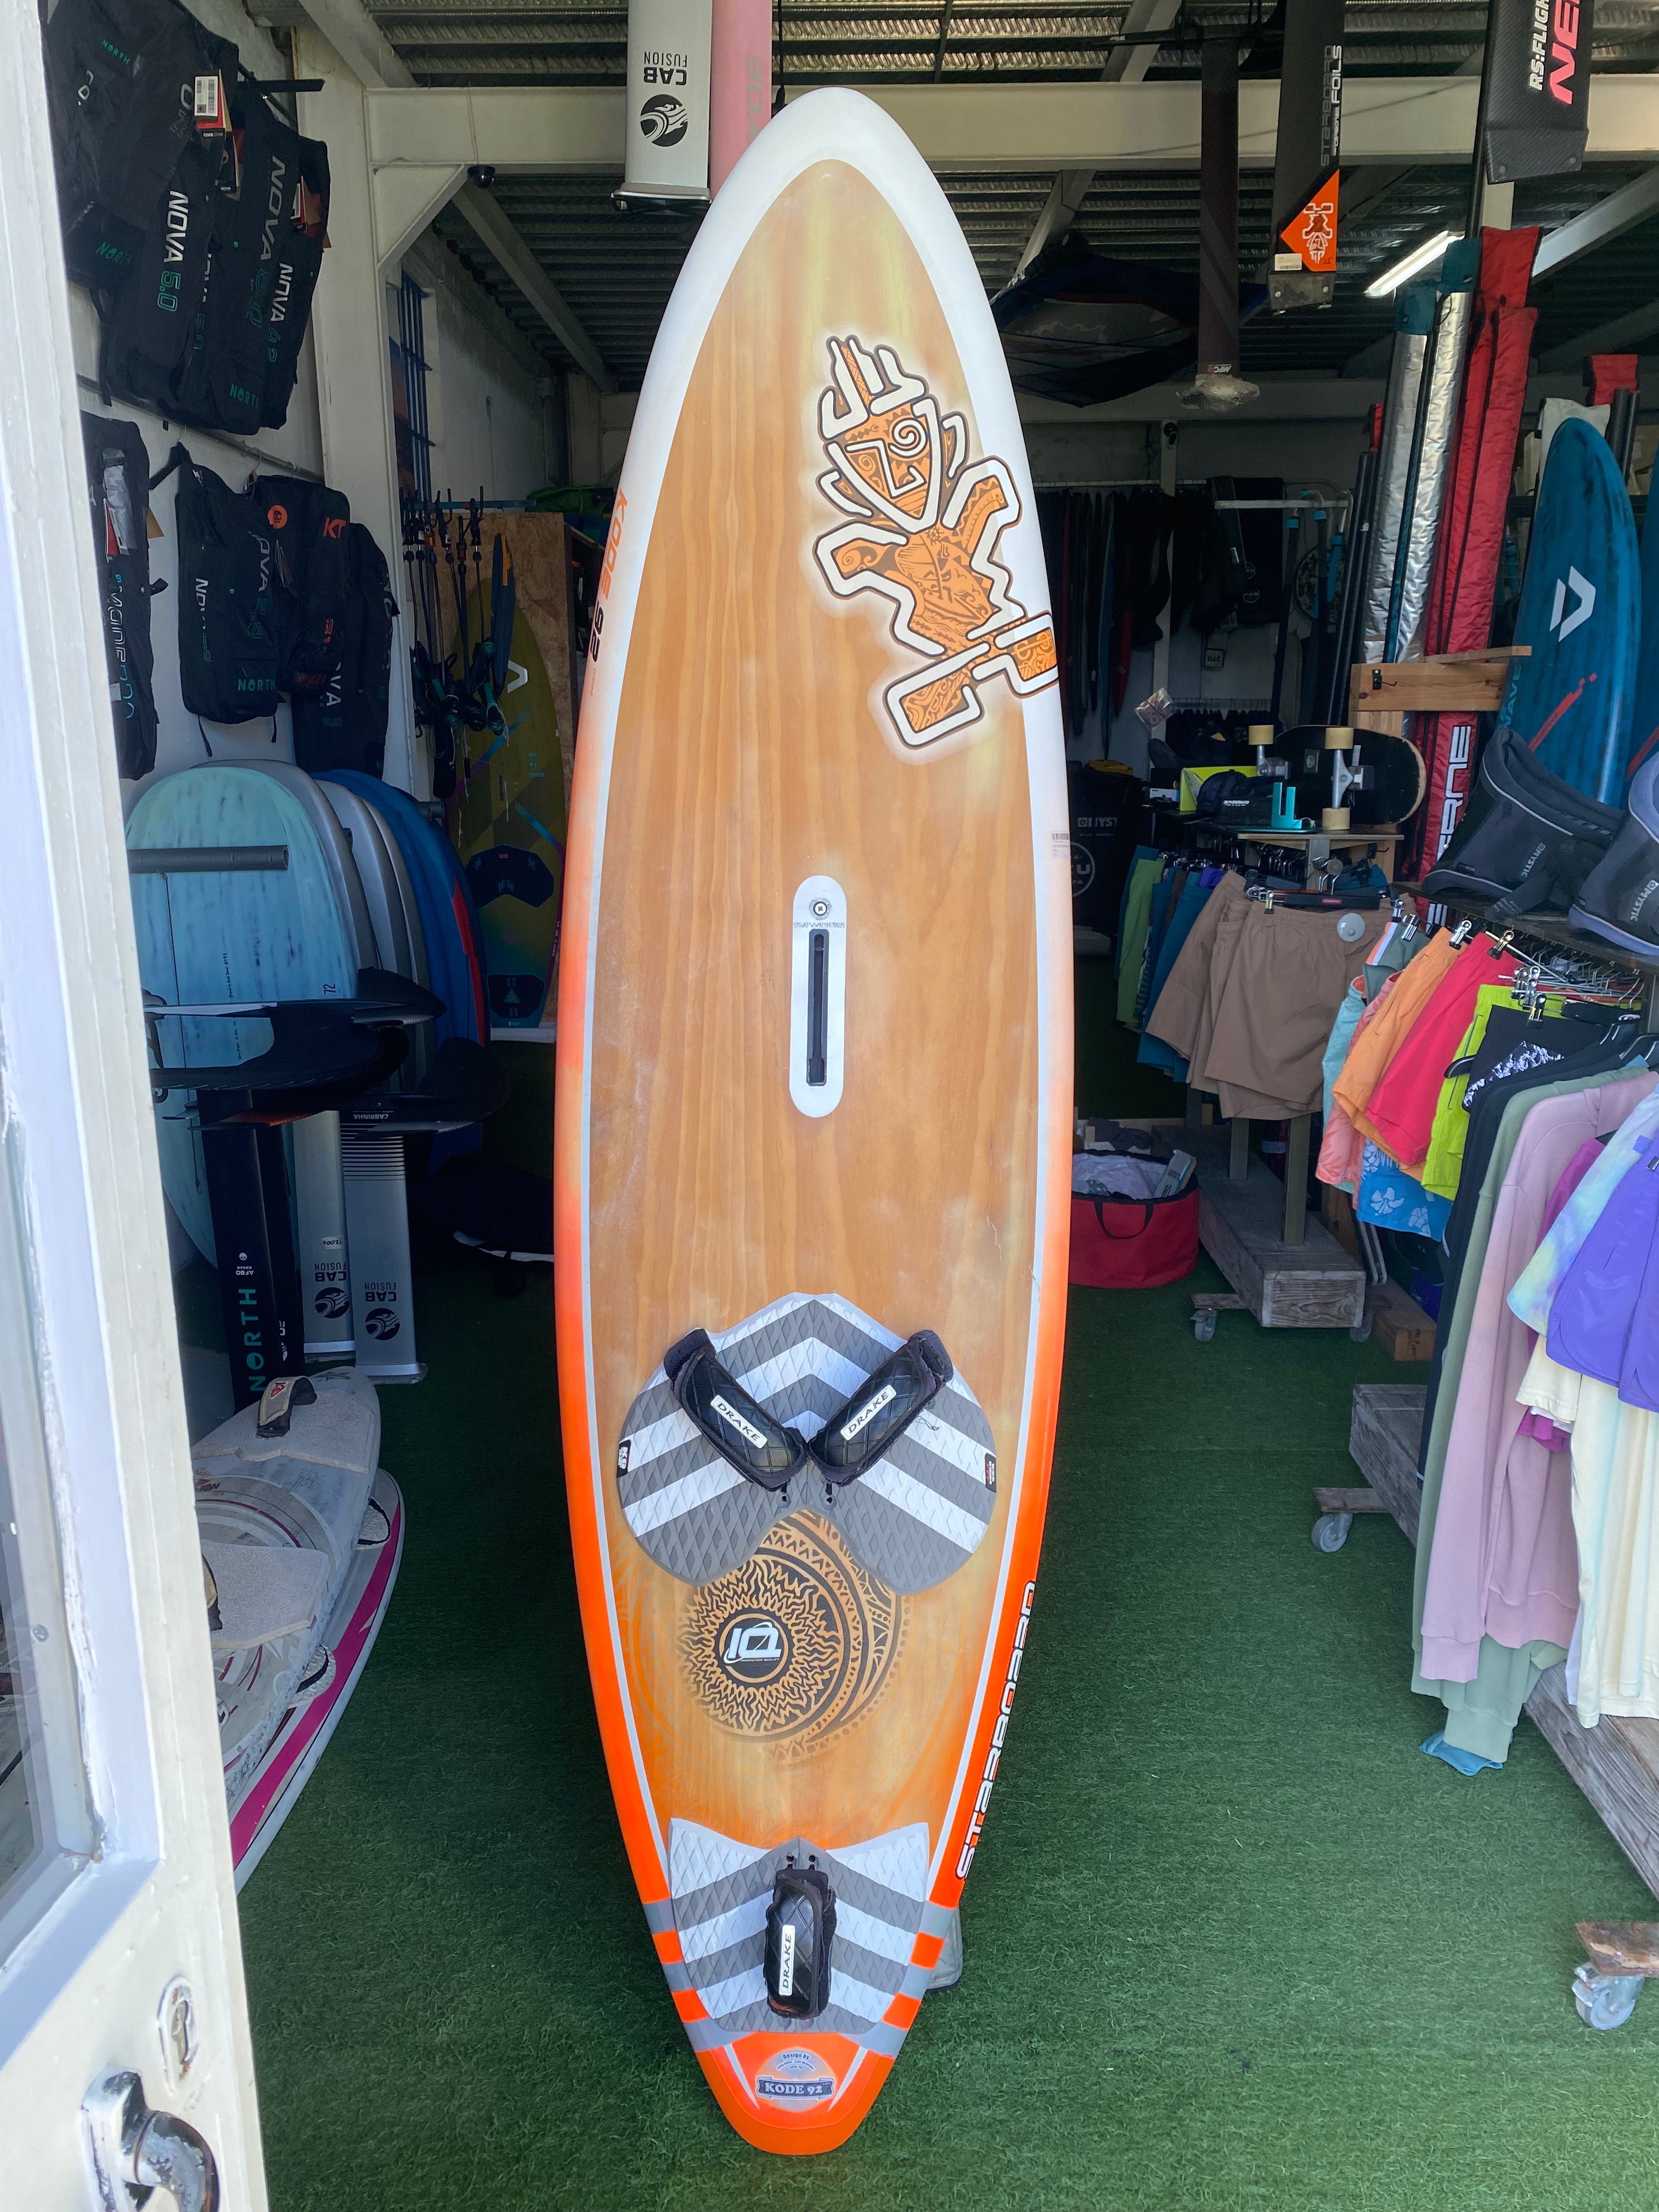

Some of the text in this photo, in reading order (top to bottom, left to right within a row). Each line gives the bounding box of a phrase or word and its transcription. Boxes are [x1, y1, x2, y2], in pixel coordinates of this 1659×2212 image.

[101, 38, 131, 65] NORTH
[644, 51, 687, 67] FUSION
[1549, 0, 1580, 105] NE
[644, 66, 687, 86] CAB
[156, 190, 189, 312] NOVA 5.0
[601, 488, 627, 600] KODE
[590, 601, 604, 663] 92
[238, 678, 276, 691] NORTH
[1521, 848, 1542, 878] MYSTIC
[1629, 888, 1652, 922] MYSTIC
[323, 983, 336, 995] 72
[314, 1262, 346, 1271] FUSION
[315, 1271, 347, 1282] CAB
[364, 1282, 397, 1291] FUSION
[364, 1291, 397, 1302] CAB
[239, 1288, 266, 1392] NORTH
[716, 1402, 760, 1442] DRAKE
[848, 1390, 890, 1434] DRAKE
[727, 1626, 782, 1659] IQ
[955, 1580, 1035, 1879] STARBOARD
[782, 1933, 791, 1989] DRAKE
[765, 2082, 823, 2095] KODE 92
